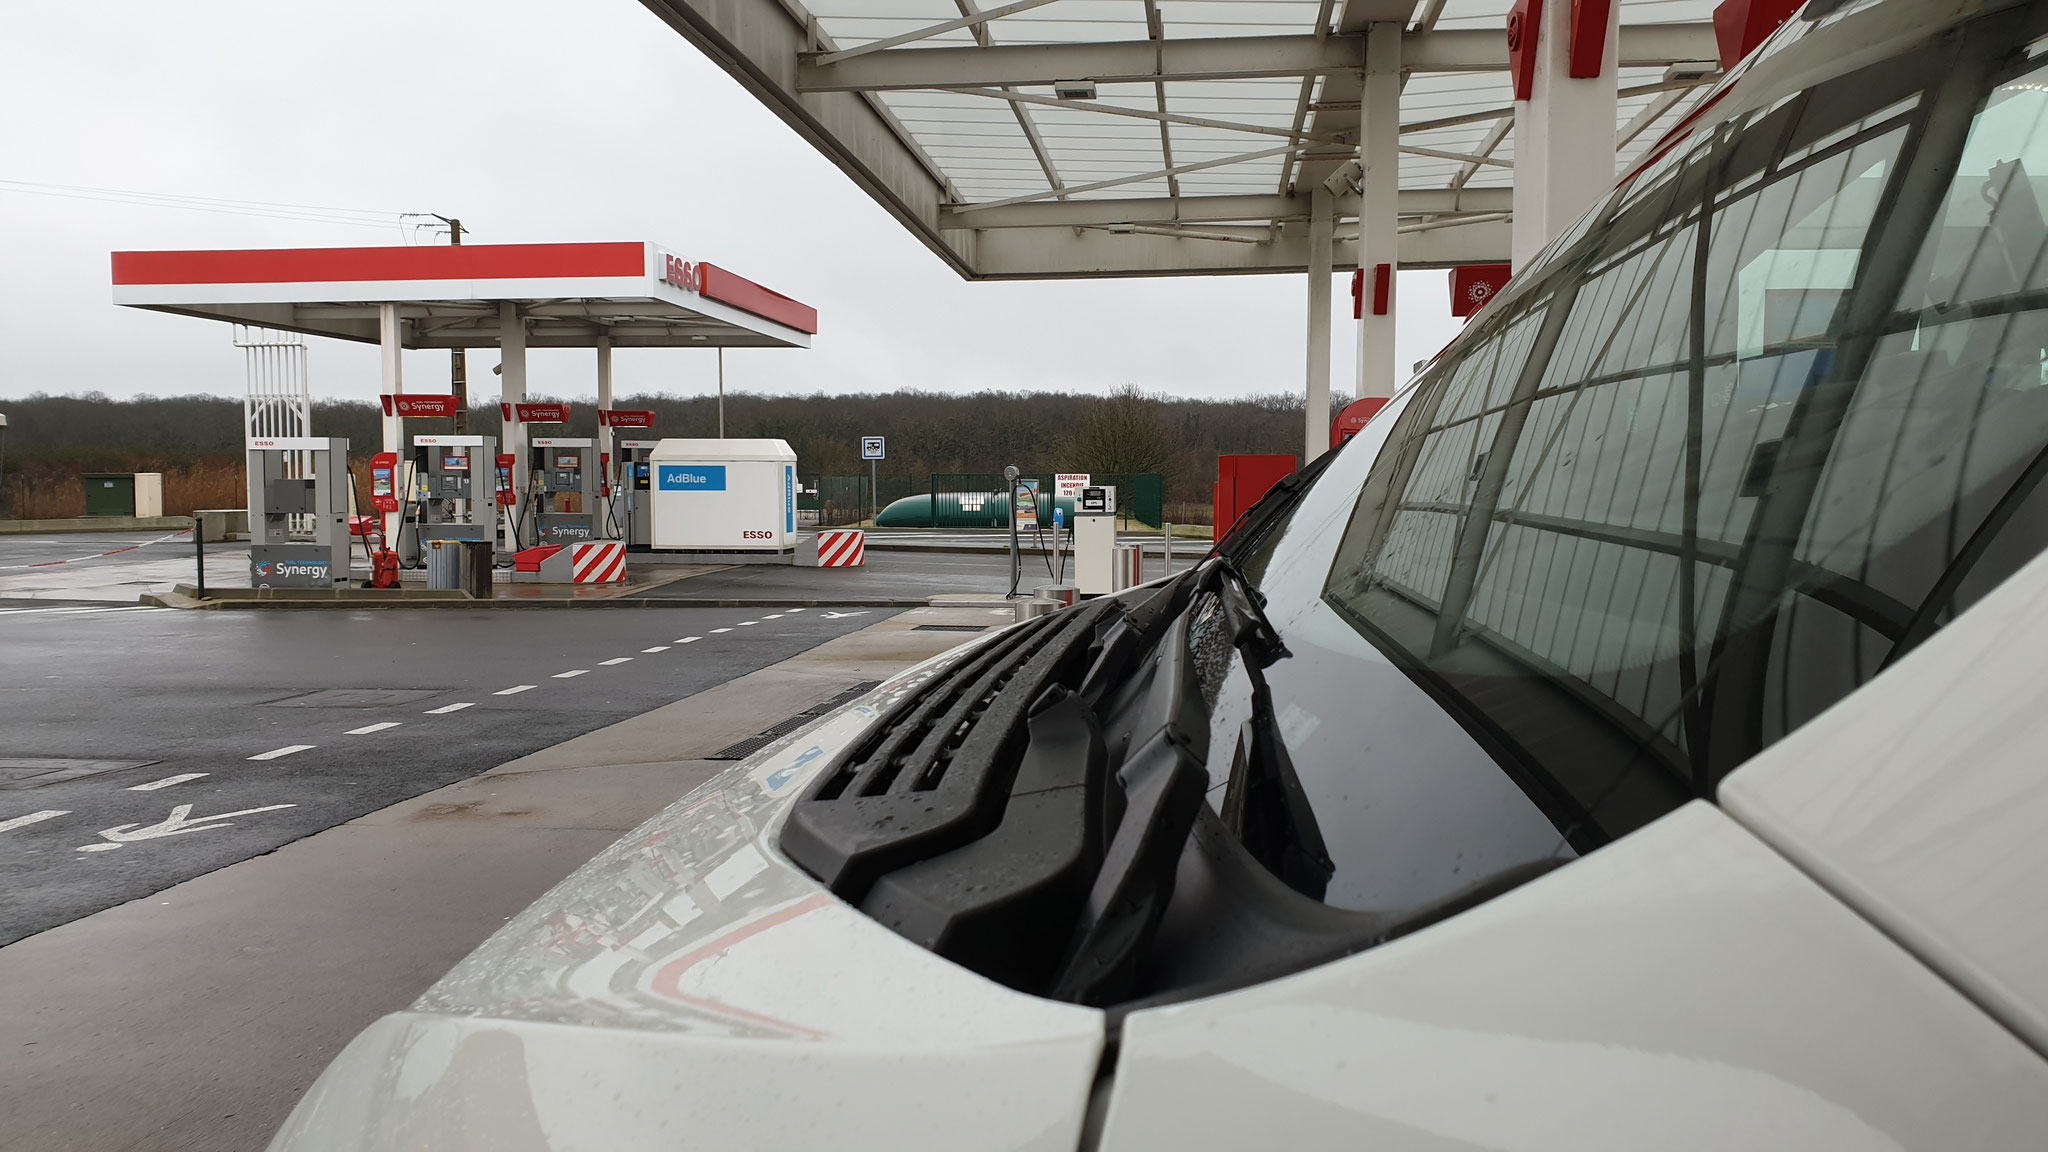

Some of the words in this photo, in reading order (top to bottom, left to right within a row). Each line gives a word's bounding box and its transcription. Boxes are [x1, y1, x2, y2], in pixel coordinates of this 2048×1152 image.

[666, 253, 702, 292] ESSO
[411, 402, 445, 411] Synergy
[531, 410, 560, 418] Synergy
[620, 416, 646, 424] Synergy
[667, 473, 707, 484] AdBlue
[552, 526, 590, 538] Synergy
[743, 531, 773, 539] ESSO
[276, 563, 328, 579] Synergy
